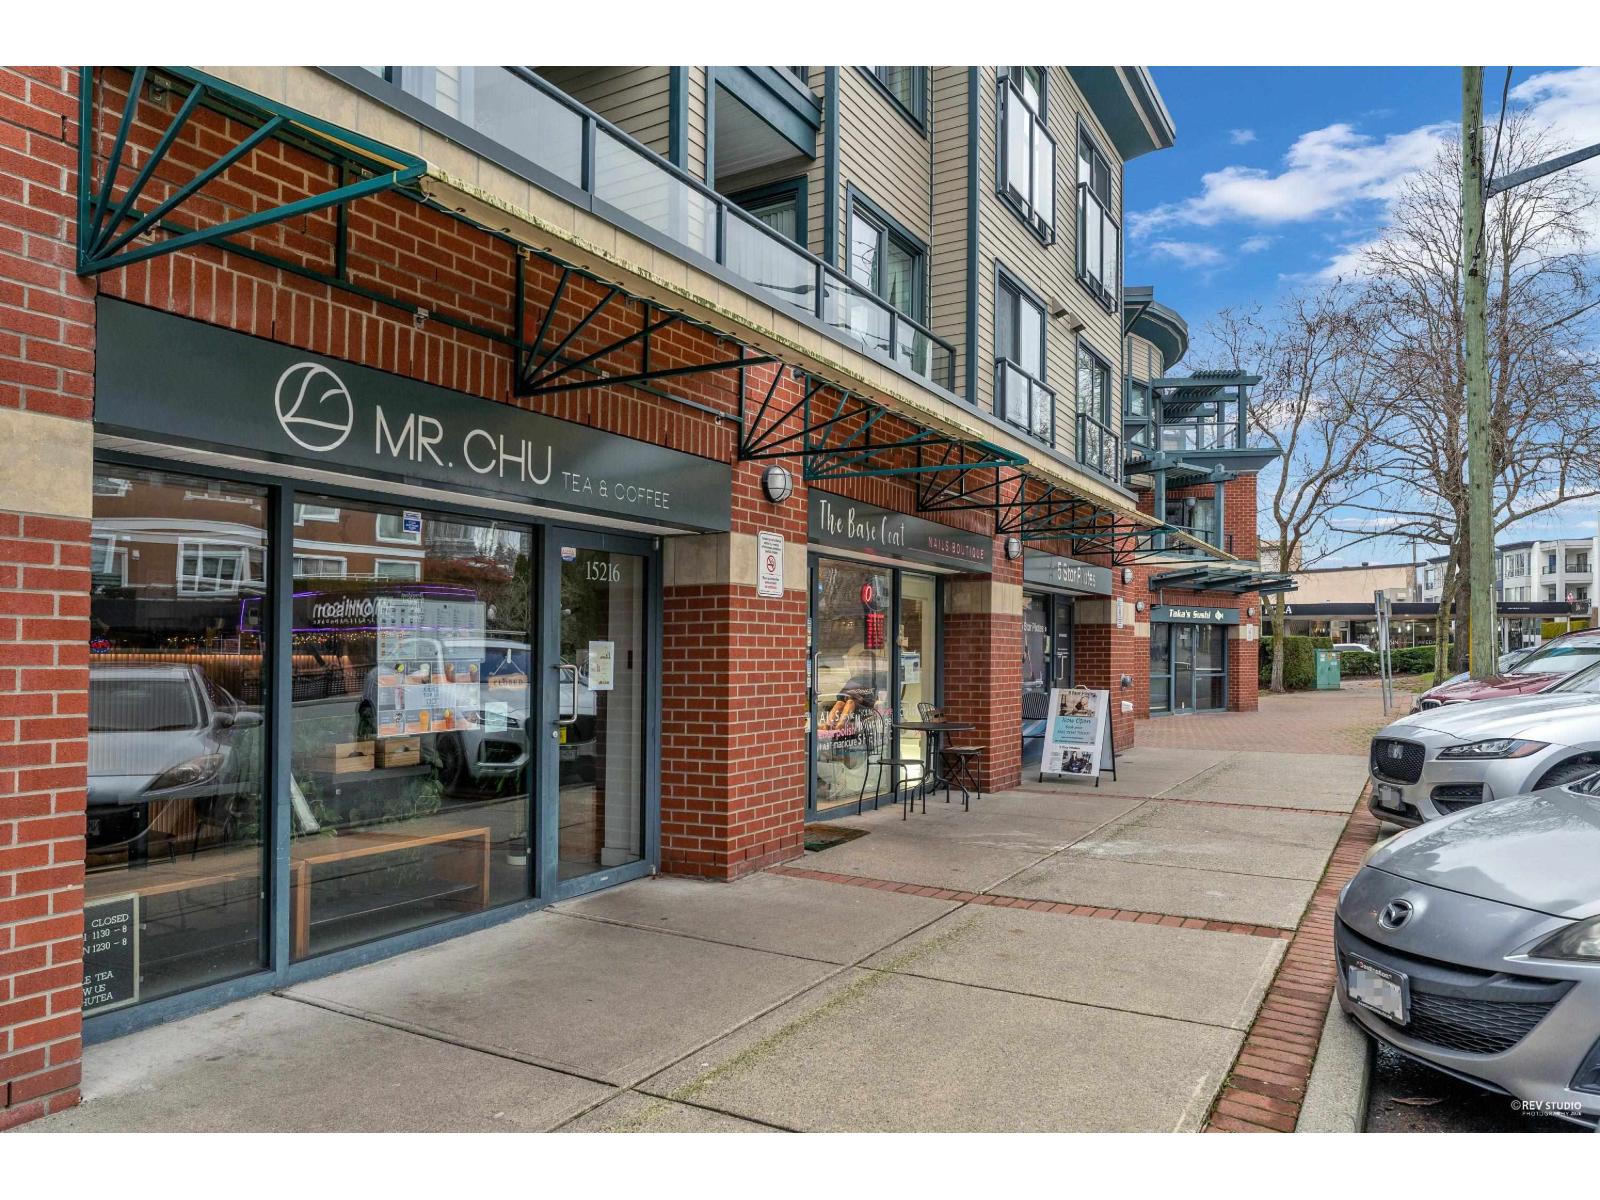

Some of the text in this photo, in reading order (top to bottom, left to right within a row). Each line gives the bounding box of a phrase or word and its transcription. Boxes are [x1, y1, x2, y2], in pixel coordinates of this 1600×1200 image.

[376, 405, 551, 485] MR. CHU
[561, 471, 670, 509] TEA & COFFEE
[820, 500, 905, 547] The Base Coat
[928, 536, 985, 560] NAILS BOUTIQUE
[586, 561, 621, 583] 15216
[1057, 562, 1062, 580] 5
[1169, 609, 1211, 619] Taka's Sushi
[91, 913, 129, 928] CLOSED
[92, 928, 110, 940] 1130
[122, 924, 127, 933] 8
[93, 941, 111, 953] 1230
[122, 937, 127, 946] 8
[84, 970, 114, 985] E TEA
[83, 984, 106, 996] W US
[83, 992, 113, 1007] HUTEA
